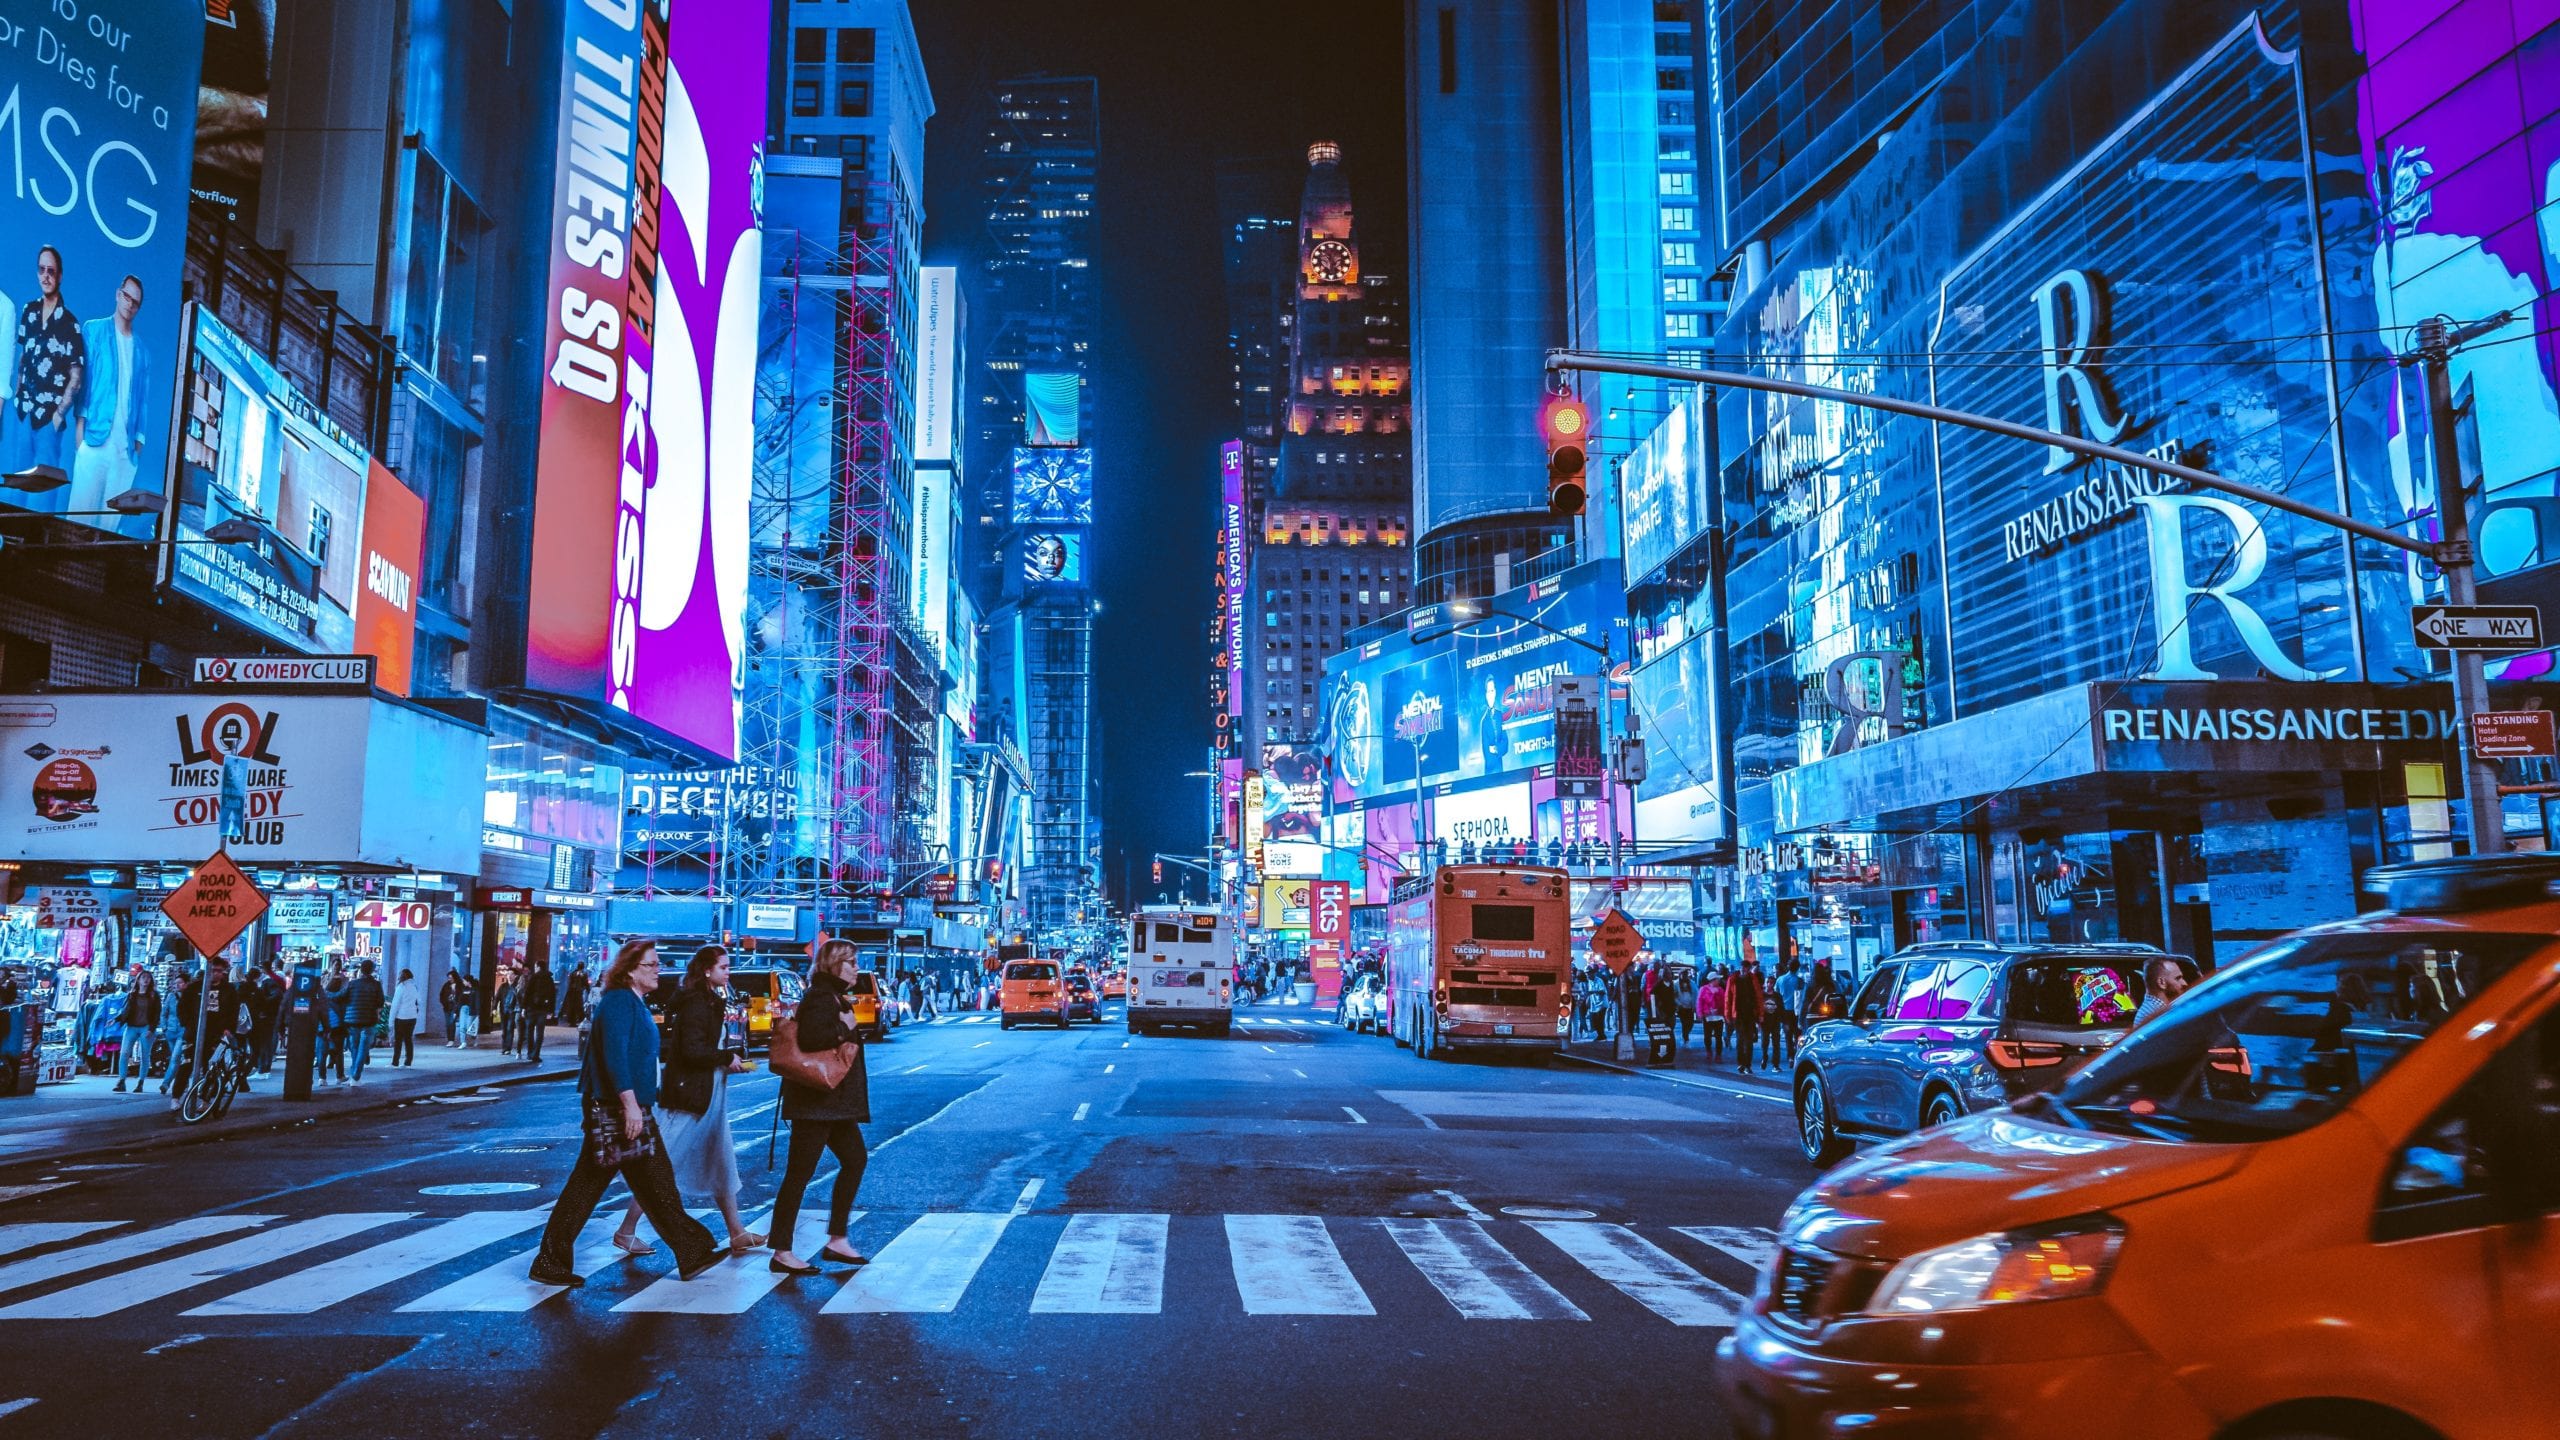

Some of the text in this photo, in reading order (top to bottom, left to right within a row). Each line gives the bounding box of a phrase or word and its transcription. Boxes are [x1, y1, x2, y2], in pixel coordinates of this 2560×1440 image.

[88, 14, 132, 52] our
[37, 26, 96, 90] Dies
[108, 64, 144, 114] for
[153, 106, 169, 131] a
[549, 37, 635, 404] TIMES SQ
[925, 278, 940, 447] WaterWipes the world's purest baby wipes
[2030, 268, 2137, 478] R
[2003, 437, 2184, 564] RENAISSANCE
[920, 486, 931, 559] #thisisparenthood
[1628, 499, 1662, 547] SANTA FE
[180, 552, 210, 586] BROOKLYN
[368, 550, 409, 612] SCAVOLINI
[1214, 529, 1227, 632] ERNST
[916, 568, 928, 618] WaterWipes
[1227, 503, 1243, 672] AMERICA'S NETWORK
[2132, 494, 2349, 683] R
[1413, 606, 1438, 620] MARRIOTT
[1613, 618, 1629, 627] TH
[2430, 619, 2528, 636] ONE WAY
[1215, 652, 1228, 668] &
[1514, 660, 1574, 693] MENTAL
[1402, 695, 1443, 719] MENTAL
[1394, 708, 1444, 741] SAMURAI
[2104, 707, 2387, 743] RENAISSANCE
[2477, 715, 2539, 725] NO STANDING
[2478, 727, 2498, 735] Hotel
[176, 702, 281, 767] LOL
[1514, 738, 1542, 754] TONIGHT
[2479, 734, 2526, 744] Loading Zone
[169, 763, 219, 787] TIMES
[717, 766, 758, 785] THE
[1557, 758, 1601, 776] RISE
[174, 790, 283, 825] CODY
[631, 785, 799, 820] DECEMBER
[1247, 799, 1264, 808] KING
[45, 823, 76, 832] TICKETS
[1453, 815, 1510, 842] SEPHORA
[1744, 847, 1763, 876] Lids
[1776, 842, 1799, 873] Lids
[199, 874, 236, 887] ROAD
[52, 889, 93, 897] HATS
[195, 889, 232, 902] WORK
[188, 904, 236, 918] AHEAD
[274, 909, 326, 917] LUGGAGE
[1320, 884, 1344, 933] tkts
[36, 915, 55, 928] 4
[1606, 925, 1626, 934] ROAD
[1453, 947, 1486, 955] TACOMA
[1528, 947, 1546, 959] tru
[1605, 938, 1626, 947] WORK
[1605, 950, 1630, 959] AHEAD
[301, 977, 310, 990] P
